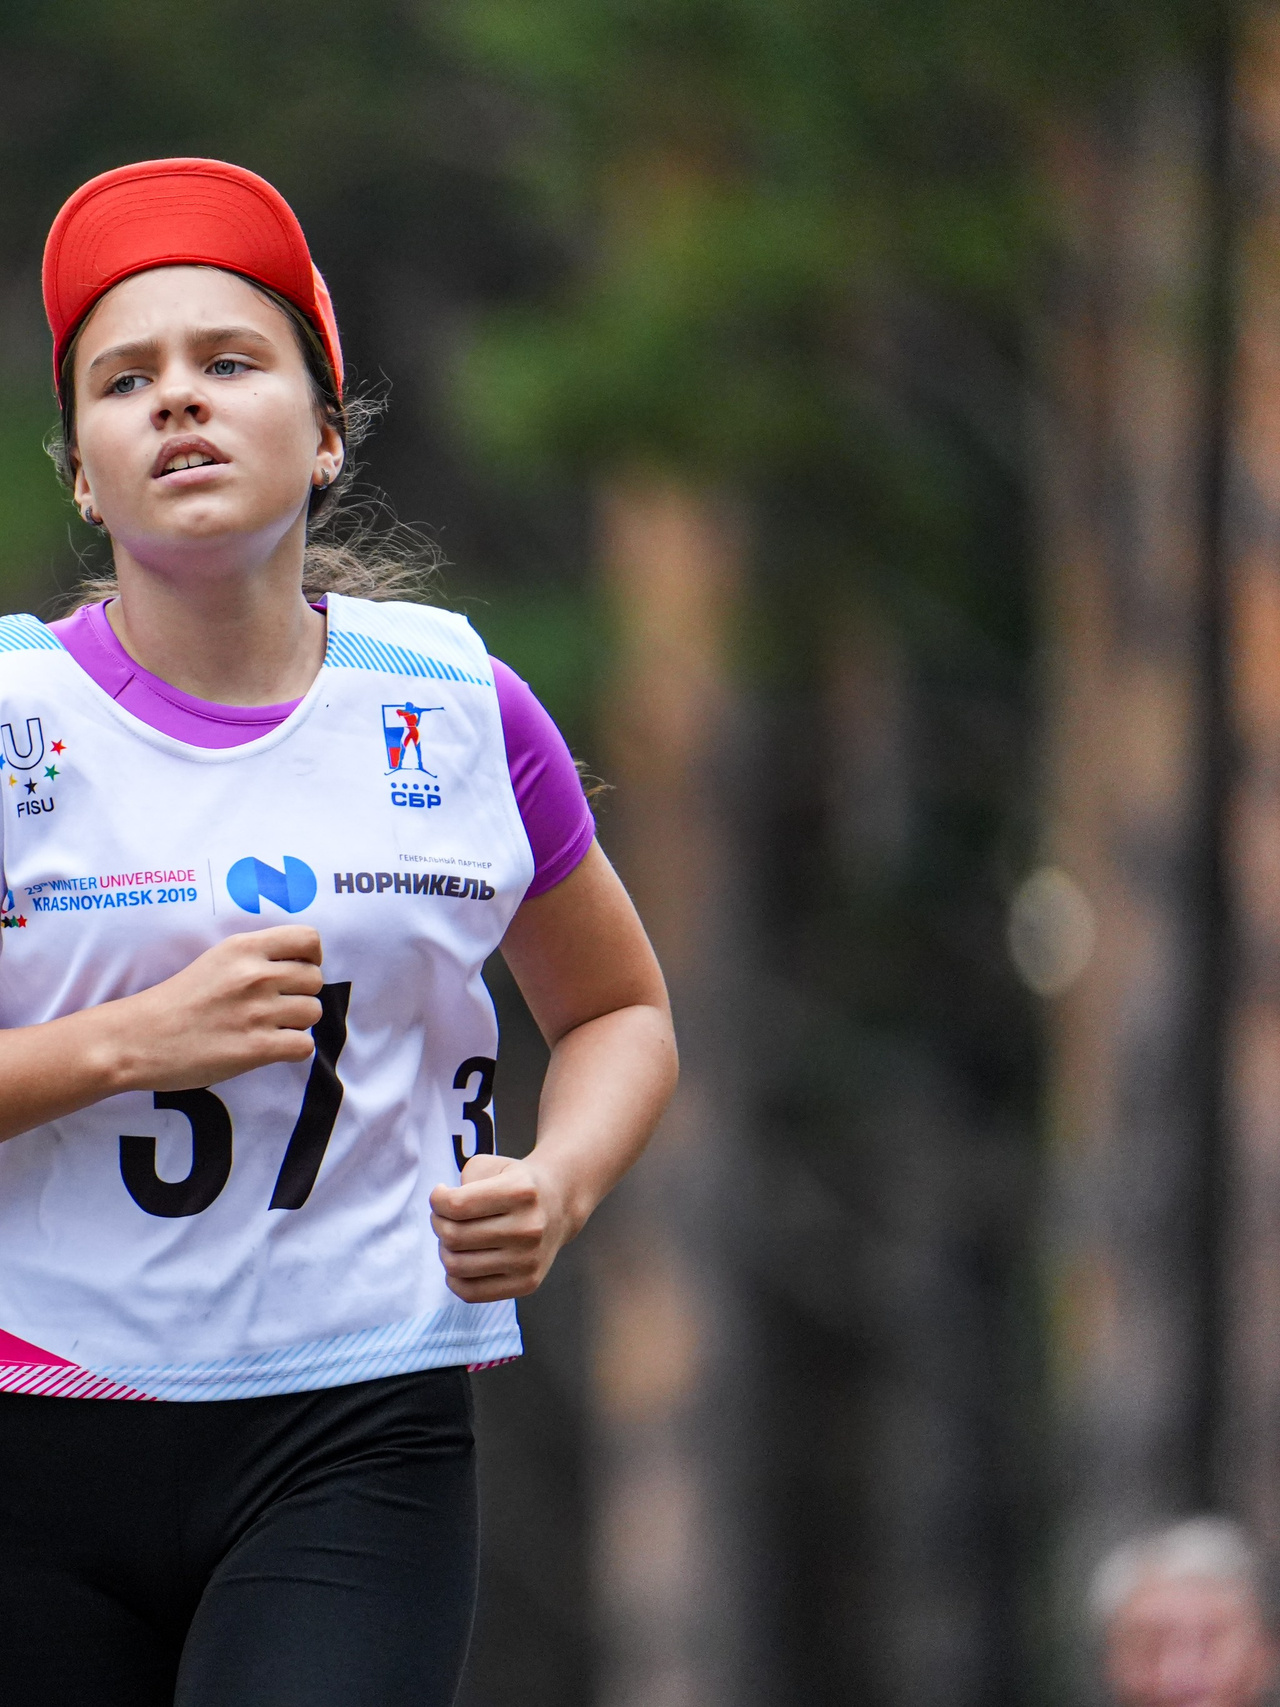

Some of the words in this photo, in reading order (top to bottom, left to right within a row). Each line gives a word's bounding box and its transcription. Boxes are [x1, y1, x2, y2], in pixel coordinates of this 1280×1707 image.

[17, 797, 55, 818] FISU
[391, 791, 442, 809] СБР
[399, 853, 456, 865] ГЕНЕРАЛЬНЫЙ
[457, 859, 493, 869] ПАРТНЕР
[48, 876, 97, 891] WINTER
[100, 869, 197, 888] UNIVERSIADE
[333, 872, 496, 901] НОРНИКЕЛЬ
[32, 889, 154, 912] KRASNOYARSK
[157, 887, 198, 904] 2019
